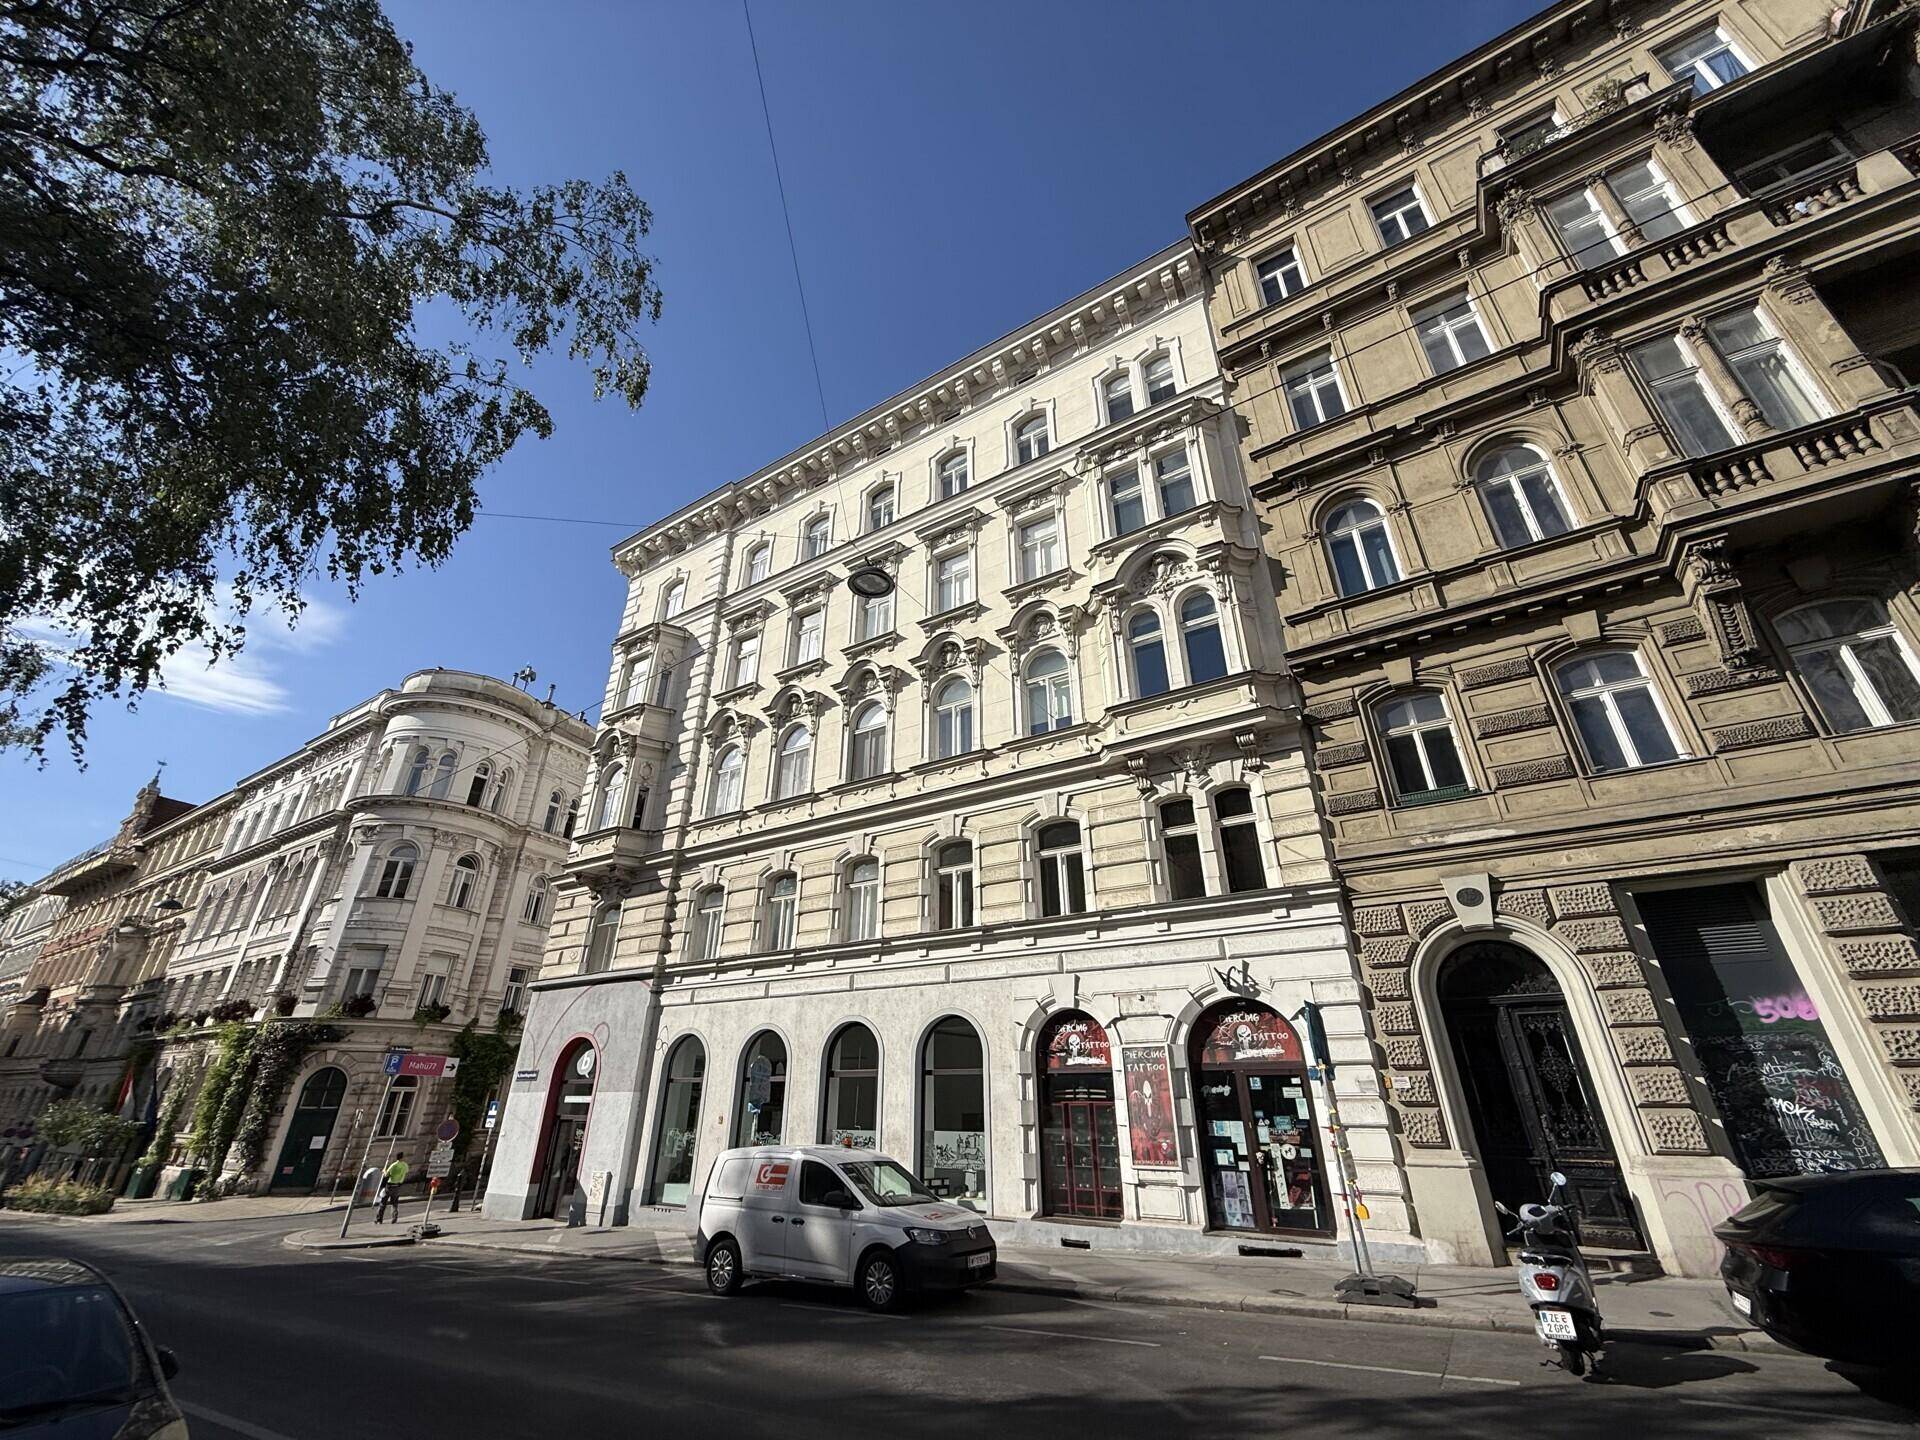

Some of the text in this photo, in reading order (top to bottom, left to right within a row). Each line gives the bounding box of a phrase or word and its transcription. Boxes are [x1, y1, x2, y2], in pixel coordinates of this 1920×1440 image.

[1252, 1032, 1289, 1041] TATTOO
[1080, 1041, 1110, 1049] TATTOO
[1123, 1049, 1166, 1059] PIERCING
[408, 1061, 437, 1070] Mahu77
[1126, 1063, 1166, 1072] TATTOO
